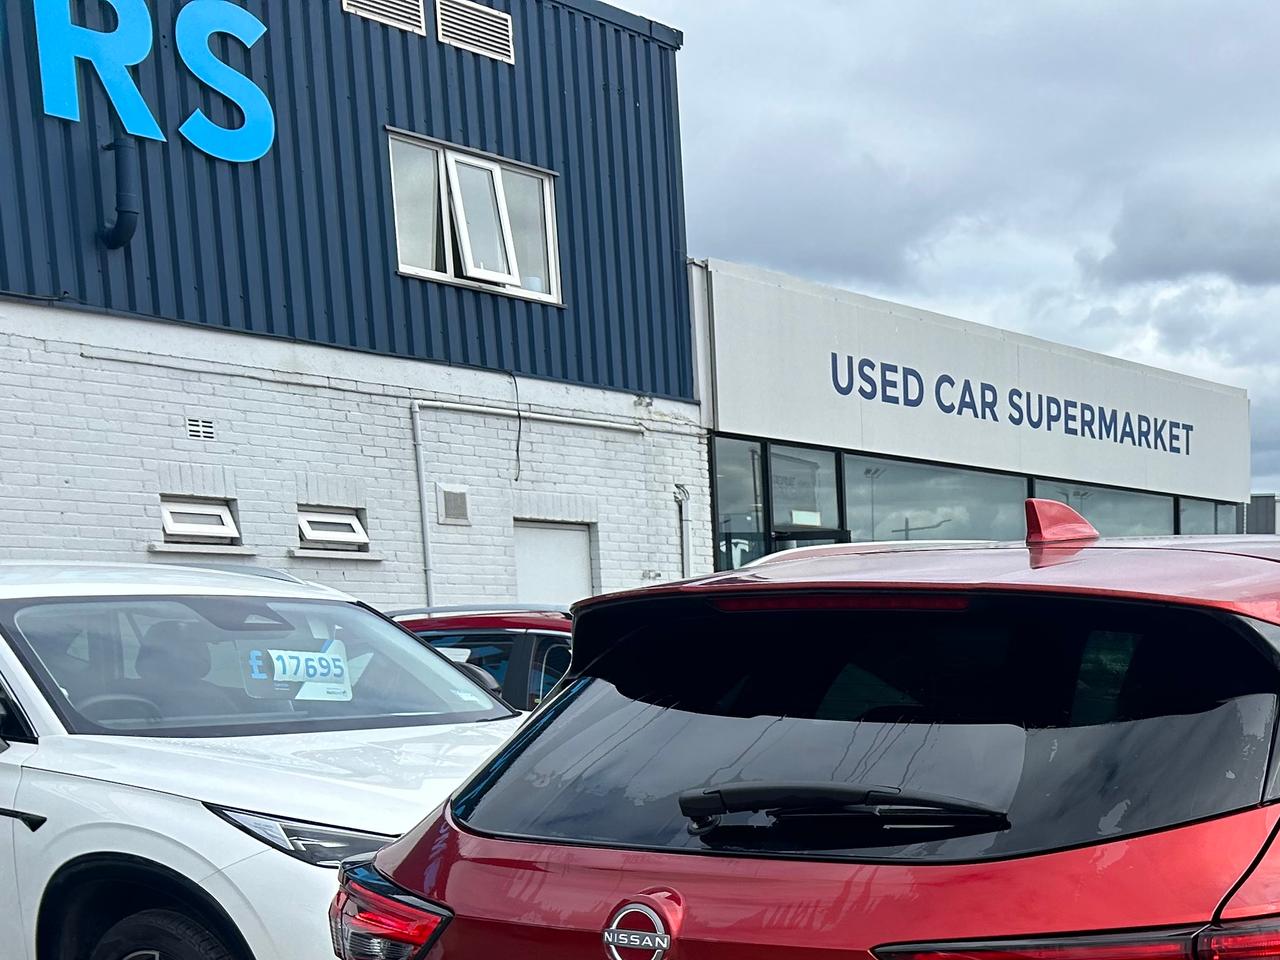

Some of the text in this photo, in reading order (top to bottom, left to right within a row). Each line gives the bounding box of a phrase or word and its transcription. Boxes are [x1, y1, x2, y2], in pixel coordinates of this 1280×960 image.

[830, 351, 1195, 456] USED CAR SUPERMARKET
[604, 931, 668, 948] NISSAN
